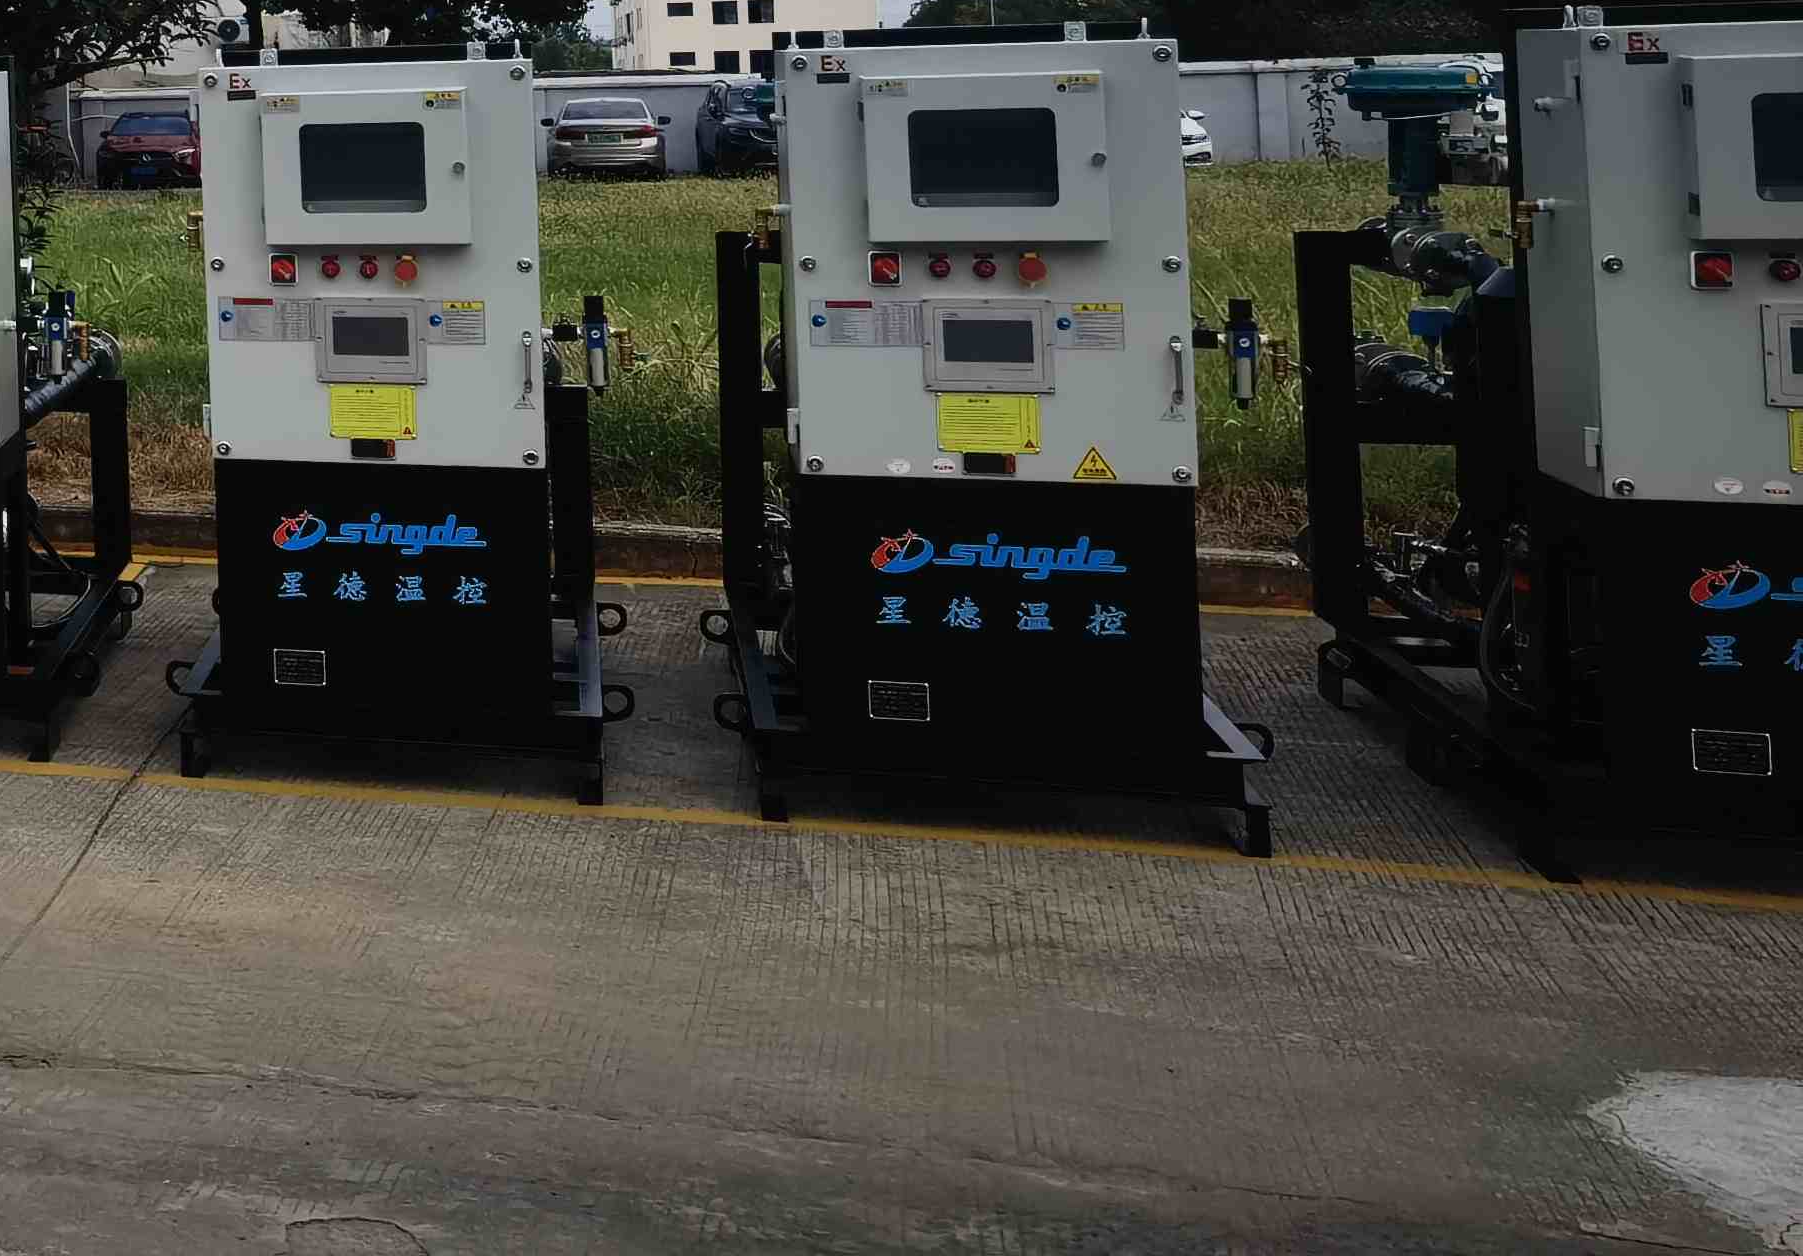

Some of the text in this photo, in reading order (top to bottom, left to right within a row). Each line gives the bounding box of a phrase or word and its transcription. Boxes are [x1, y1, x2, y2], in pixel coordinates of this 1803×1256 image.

[1627, 31, 1660, 51] Ex
[229, 73, 252, 89] Ex
[821, 55, 846, 72] Ex
[326, 512, 488, 556] singde
[932, 532, 1129, 581] singde
[276, 570, 487, 607] 星德温控
[875, 595, 1128, 637] 星德温控
